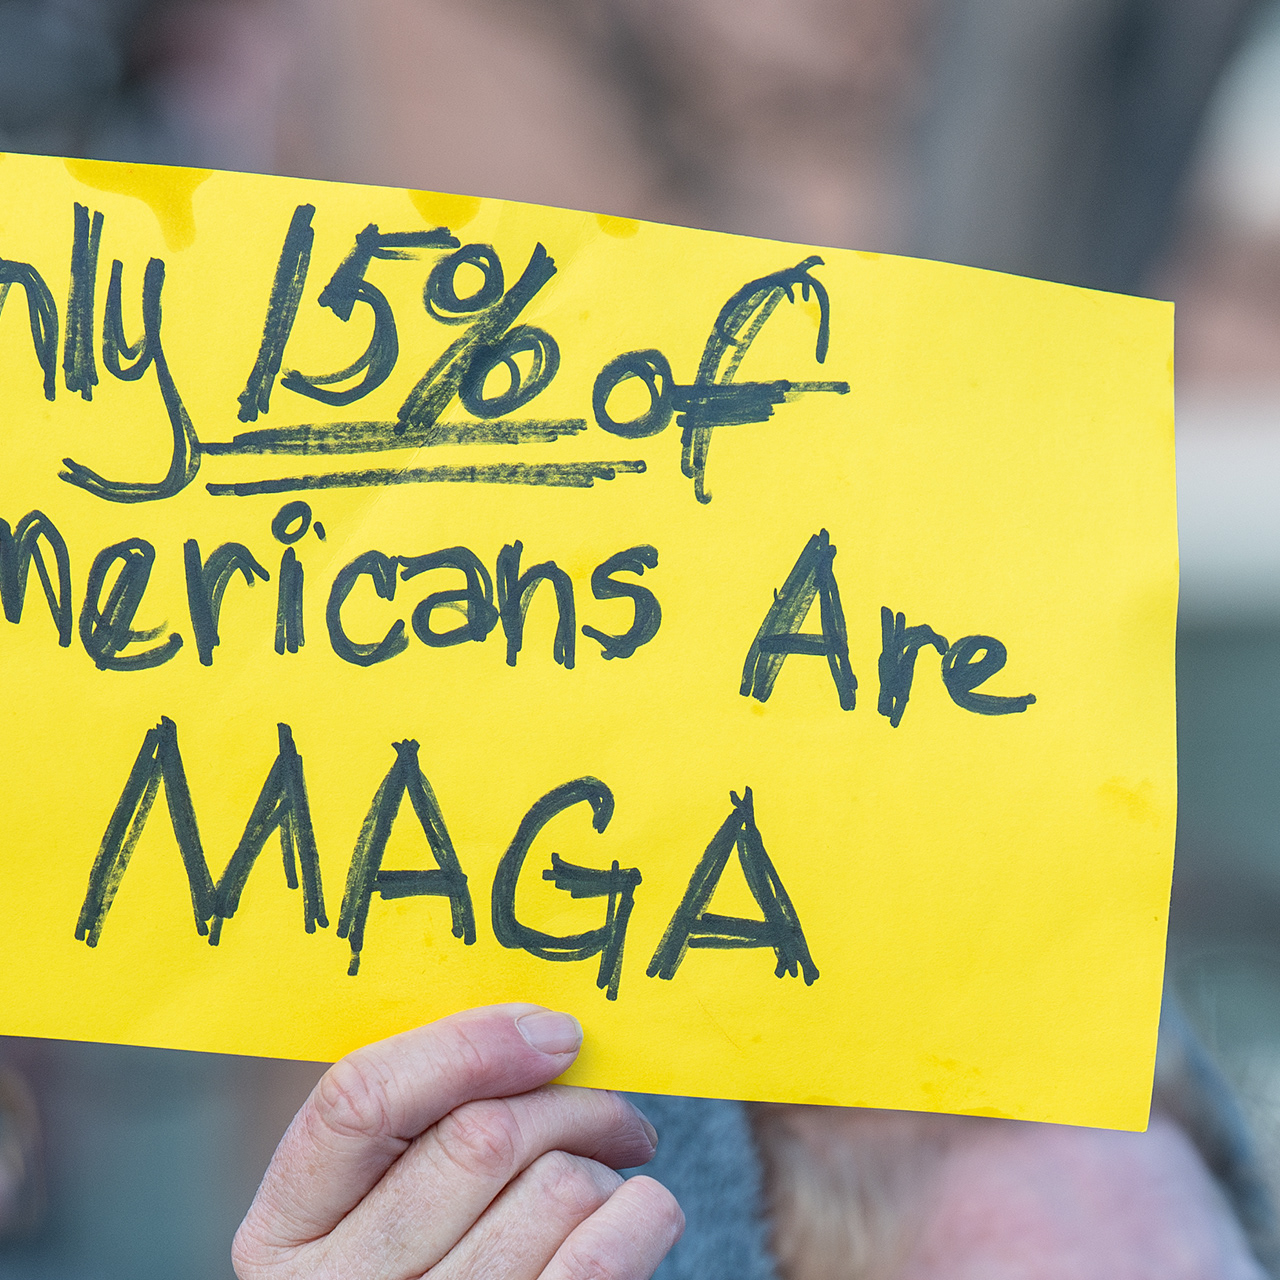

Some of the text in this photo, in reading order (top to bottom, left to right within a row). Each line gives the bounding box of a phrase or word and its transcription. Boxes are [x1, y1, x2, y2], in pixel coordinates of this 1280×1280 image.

[237, 203, 558, 431] 15%
[592, 254, 849, 504] of
[740, 528, 1036, 727] Are
[74, 714, 820, 1002] MAGA
